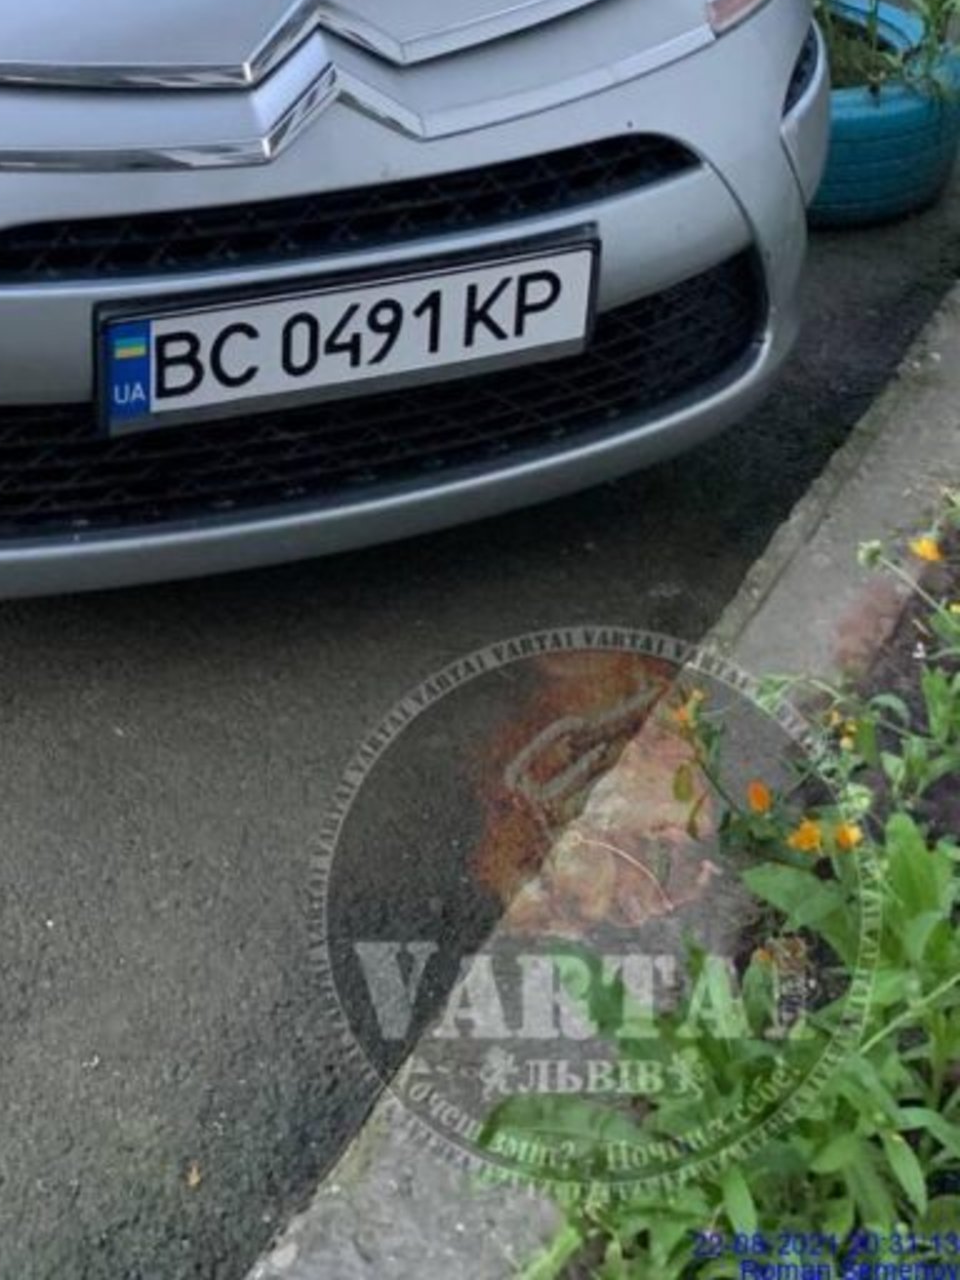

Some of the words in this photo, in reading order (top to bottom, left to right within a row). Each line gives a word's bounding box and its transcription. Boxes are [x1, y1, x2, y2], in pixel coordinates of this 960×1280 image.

[155, 322, 259, 399] BC
[282, 290, 442, 378] 0491
[463, 270, 561, 348] KP
[114, 384, 146, 405] UA
